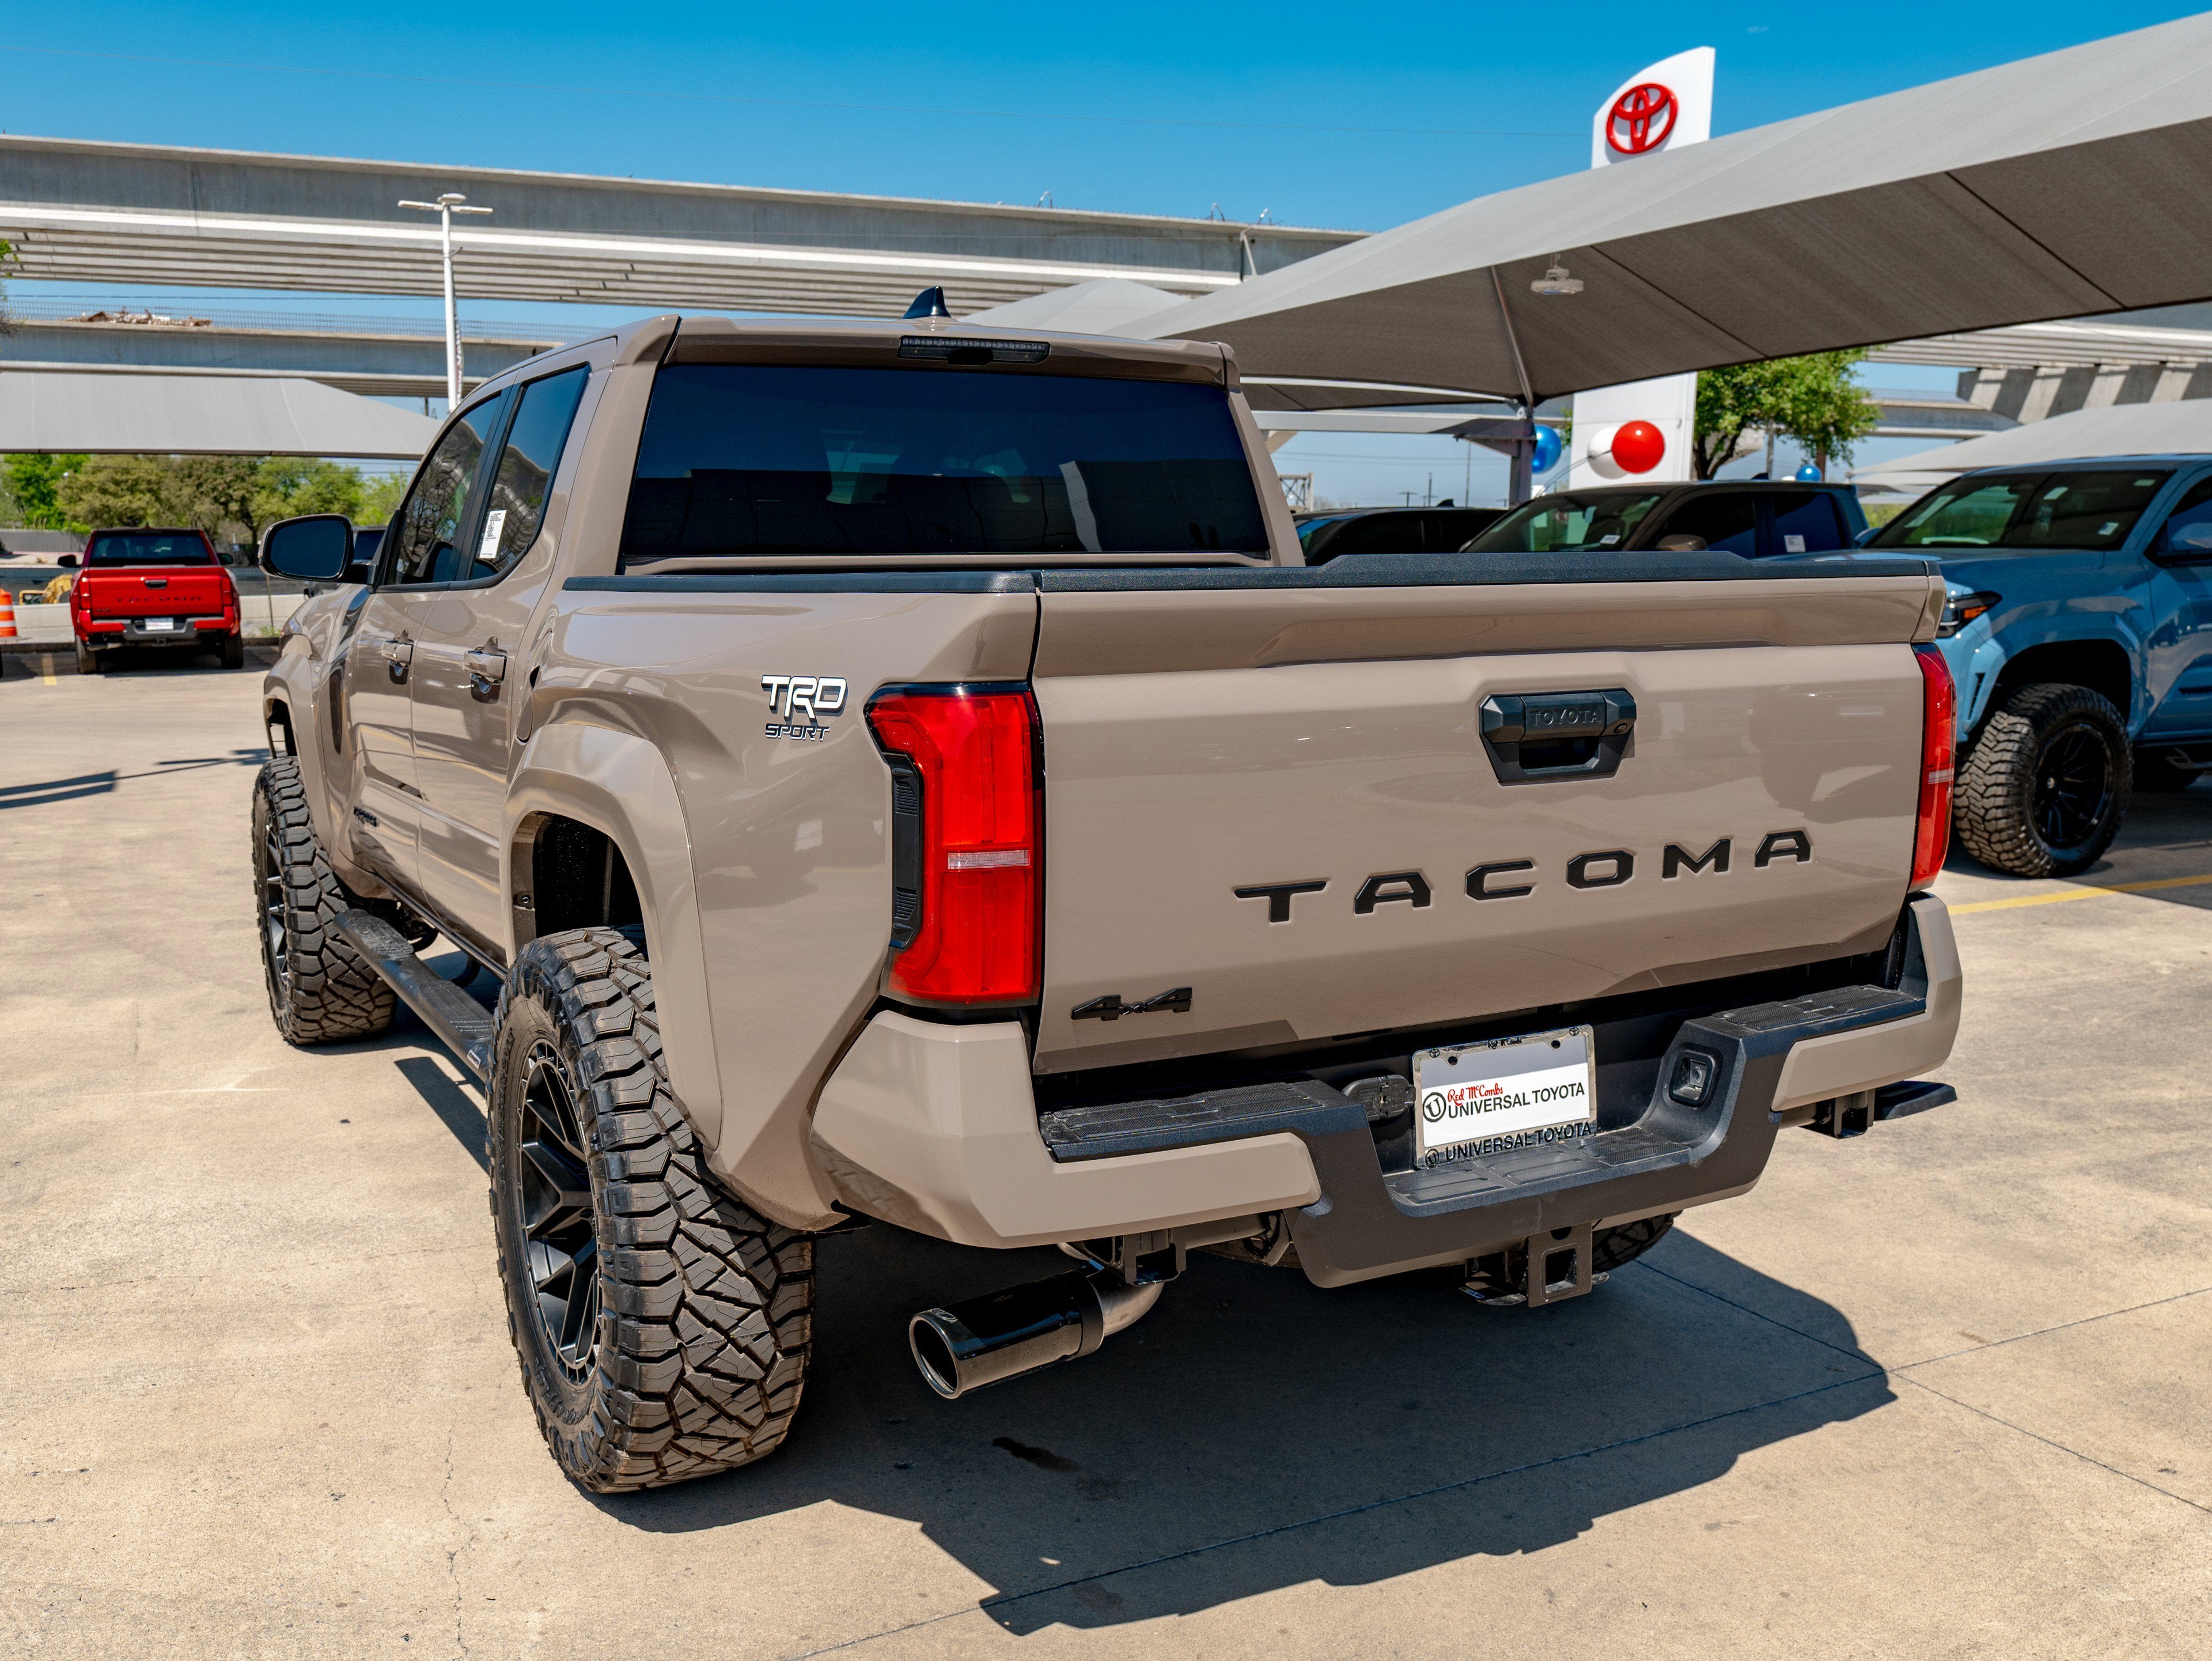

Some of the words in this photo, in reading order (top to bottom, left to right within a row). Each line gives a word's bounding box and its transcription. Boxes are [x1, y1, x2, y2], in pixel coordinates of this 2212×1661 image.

[761, 675, 847, 721] TRD
[765, 723, 830, 741] SPORT
[1529, 707, 1602, 727] TOYOTA
[1232, 829, 1813, 923] TACOMA
[1448, 1088, 1464, 1107] Red
[1465, 1083, 1503, 1099] McCombs
[1448, 1092, 1531, 1119] UNIVERSAL
[1532, 1082, 1585, 1103] TOYOTA
[1445, 1132, 1533, 1161] UNIVERSAL
[1533, 1121, 1592, 1144] TOYOTA
